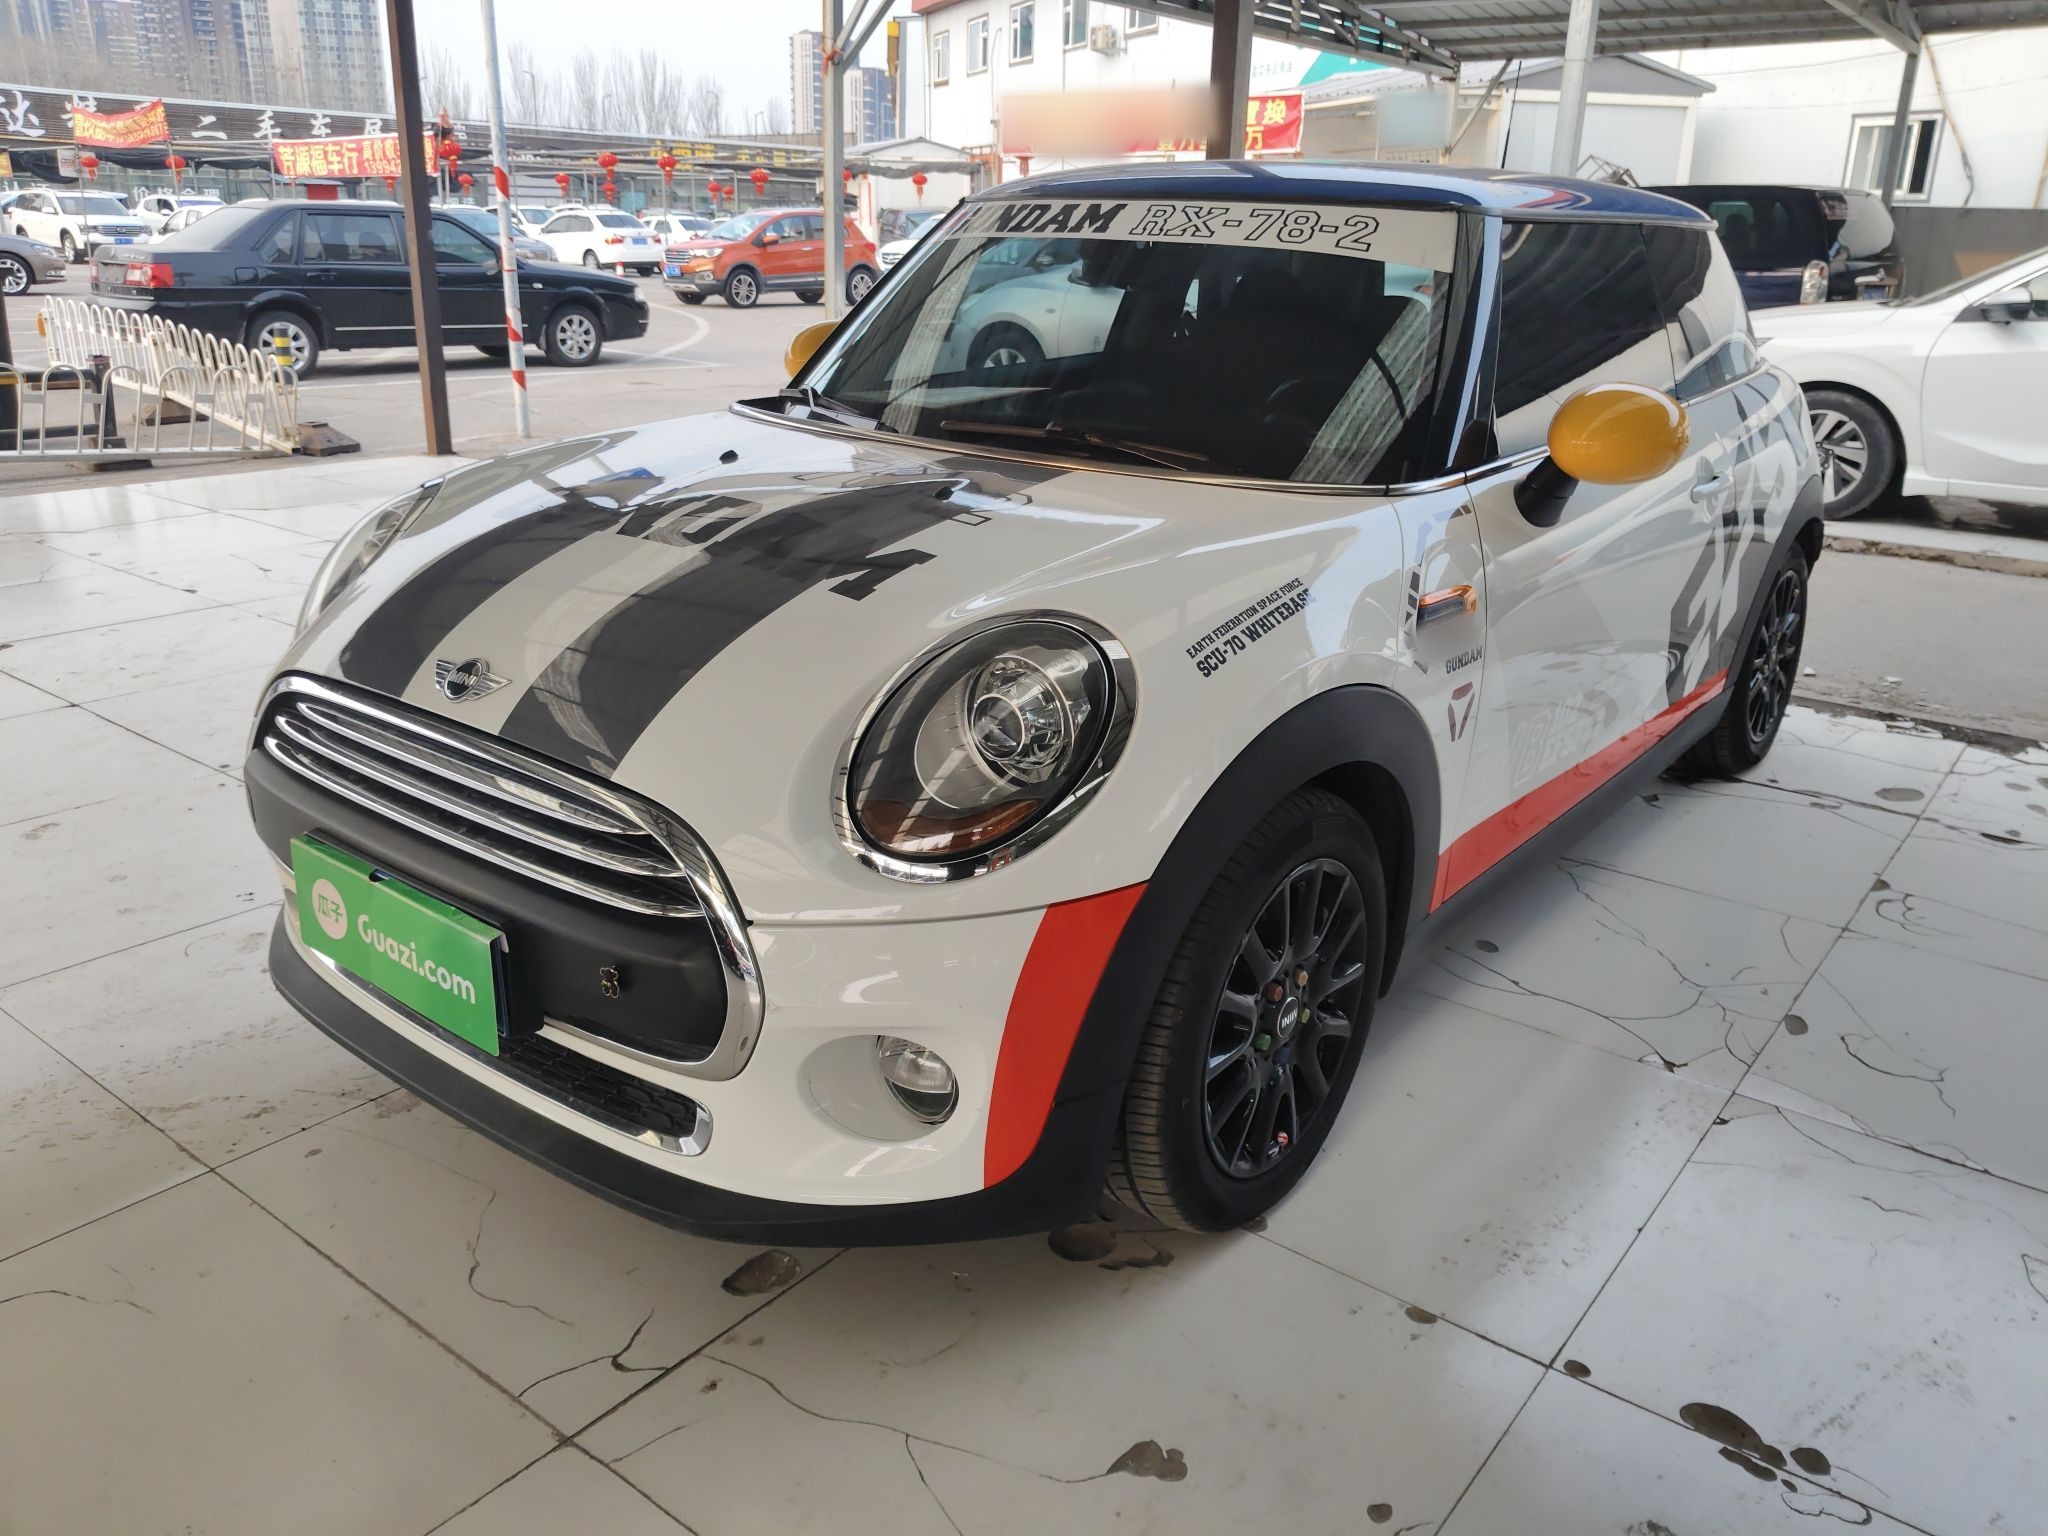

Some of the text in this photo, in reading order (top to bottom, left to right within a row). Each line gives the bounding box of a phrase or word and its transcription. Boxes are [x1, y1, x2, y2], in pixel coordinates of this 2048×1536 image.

[278, 141, 359, 177] 芳源福车行
[1128, 204, 1381, 253] RX-78-2
[1186, 633, 1216, 660] EARTH
[1256, 589, 1283, 611] SPACE
[1278, 577, 1304, 597] FORCE
[1196, 587, 1317, 678] SCU-70 WHITEBASE
[448, 671, 478, 688] MINI
[1445, 645, 1483, 674] GUNDAM
[316, 893, 344, 924] 瓜子
[357, 914, 476, 1005] Guazi.com
